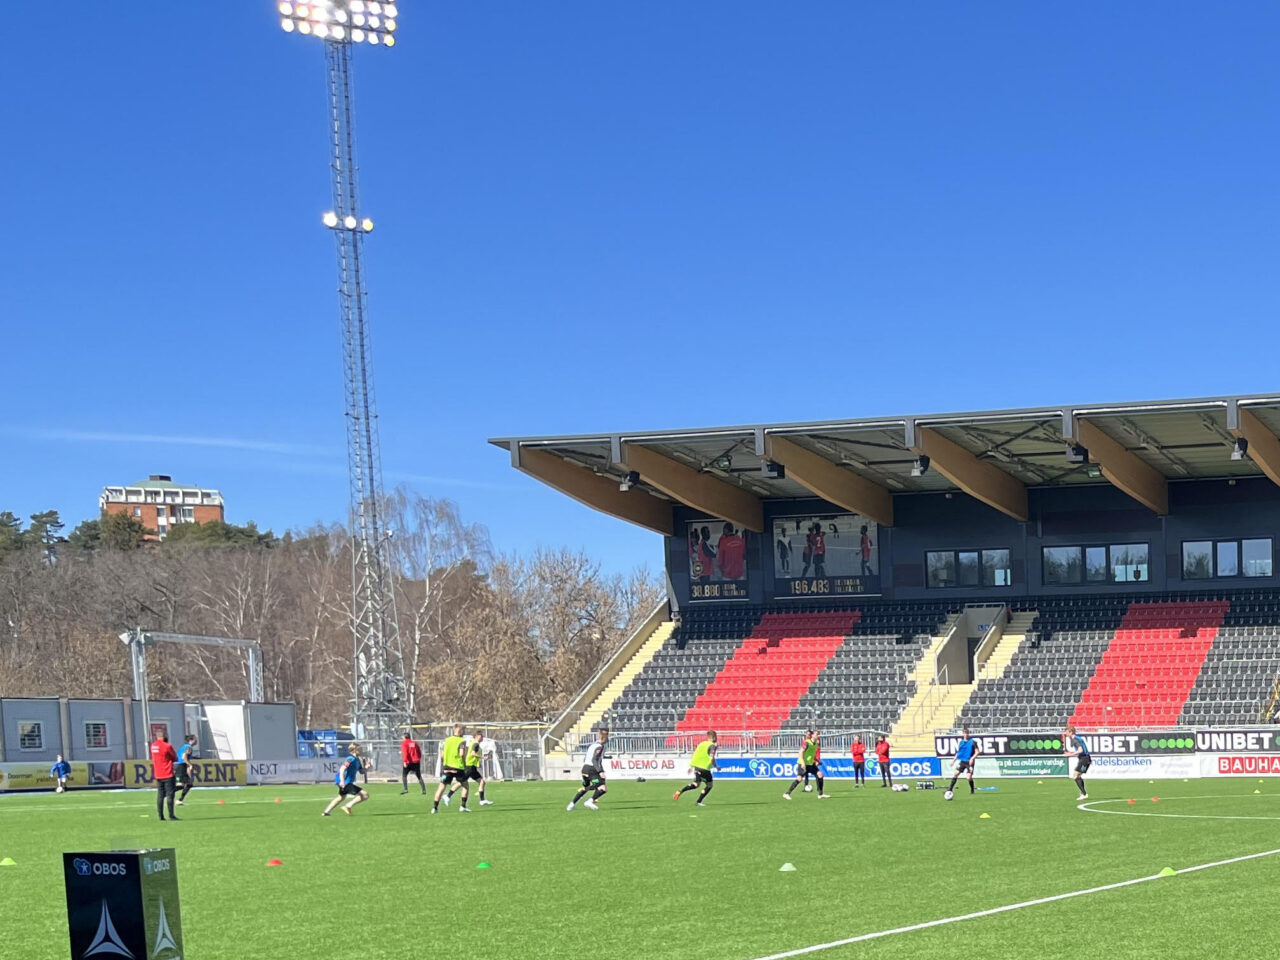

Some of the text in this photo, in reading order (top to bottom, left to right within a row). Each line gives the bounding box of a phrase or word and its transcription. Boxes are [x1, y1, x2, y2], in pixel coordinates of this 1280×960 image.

[1197, 733, 1273, 750] UNIBET
[250, 764, 278, 775] NEXT
[611, 760, 675, 769] ML DEMO AB
[890, 762, 931, 775] OBOS
[93, 863, 126, 875] OBOS
[153, 859, 170, 872] OBOS
